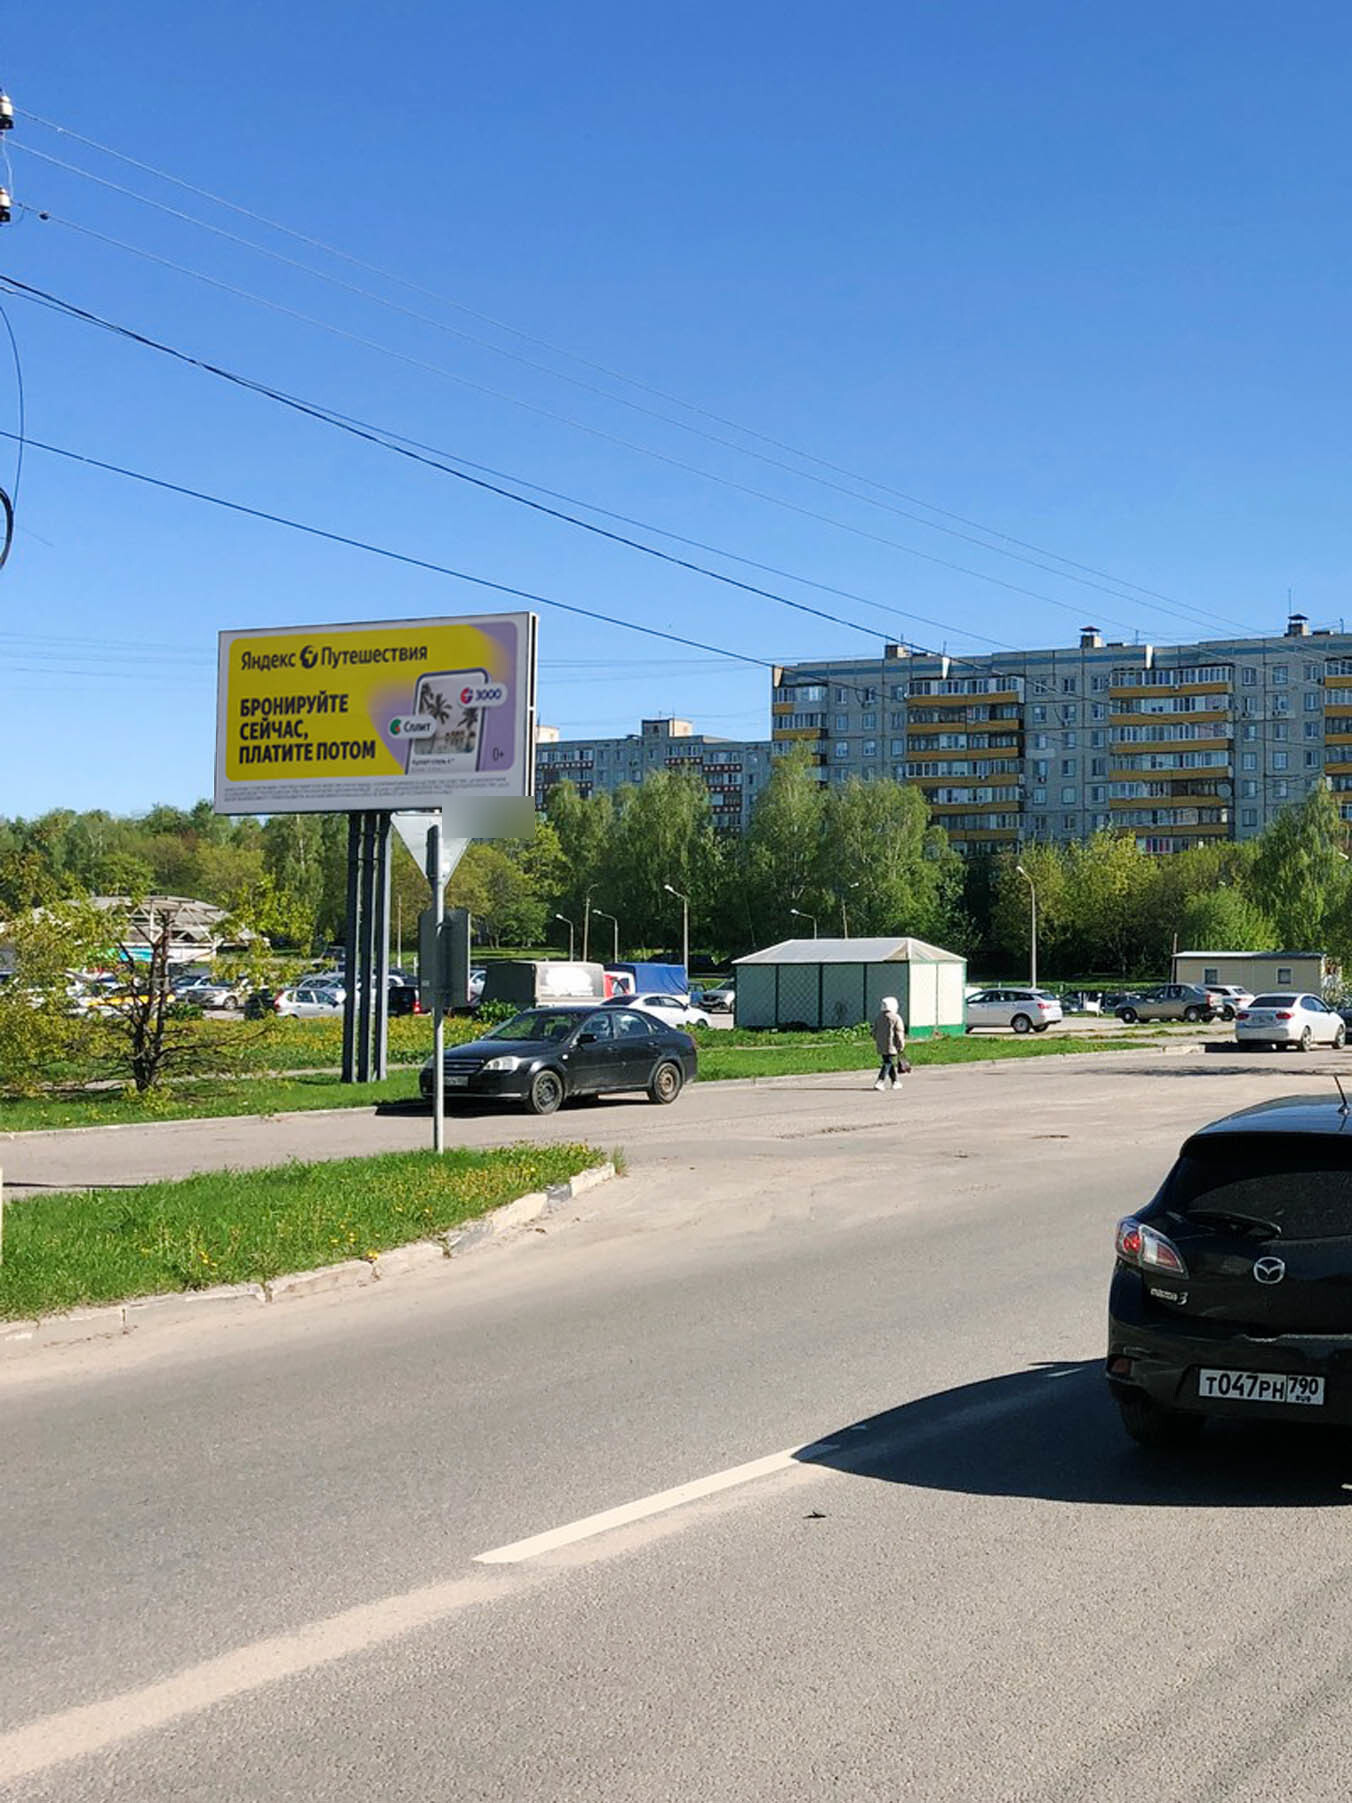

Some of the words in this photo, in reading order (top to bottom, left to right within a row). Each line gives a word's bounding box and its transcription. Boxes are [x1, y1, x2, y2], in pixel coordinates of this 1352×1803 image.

[241, 651, 297, 672] Яндекс
[321, 646, 428, 669] Путешествия
[240, 690, 349, 717] БРОНИРУЙТЕ
[240, 717, 309, 740] СЕЙЧАС,
[403, 720, 431, 733] Сплит
[239, 743, 313, 764] ПЛАТИТЕ
[316, 740, 376, 761] ПОТОМ
[492, 747, 504, 761] 0+
[1289, 1376, 1319, 1396] 790
